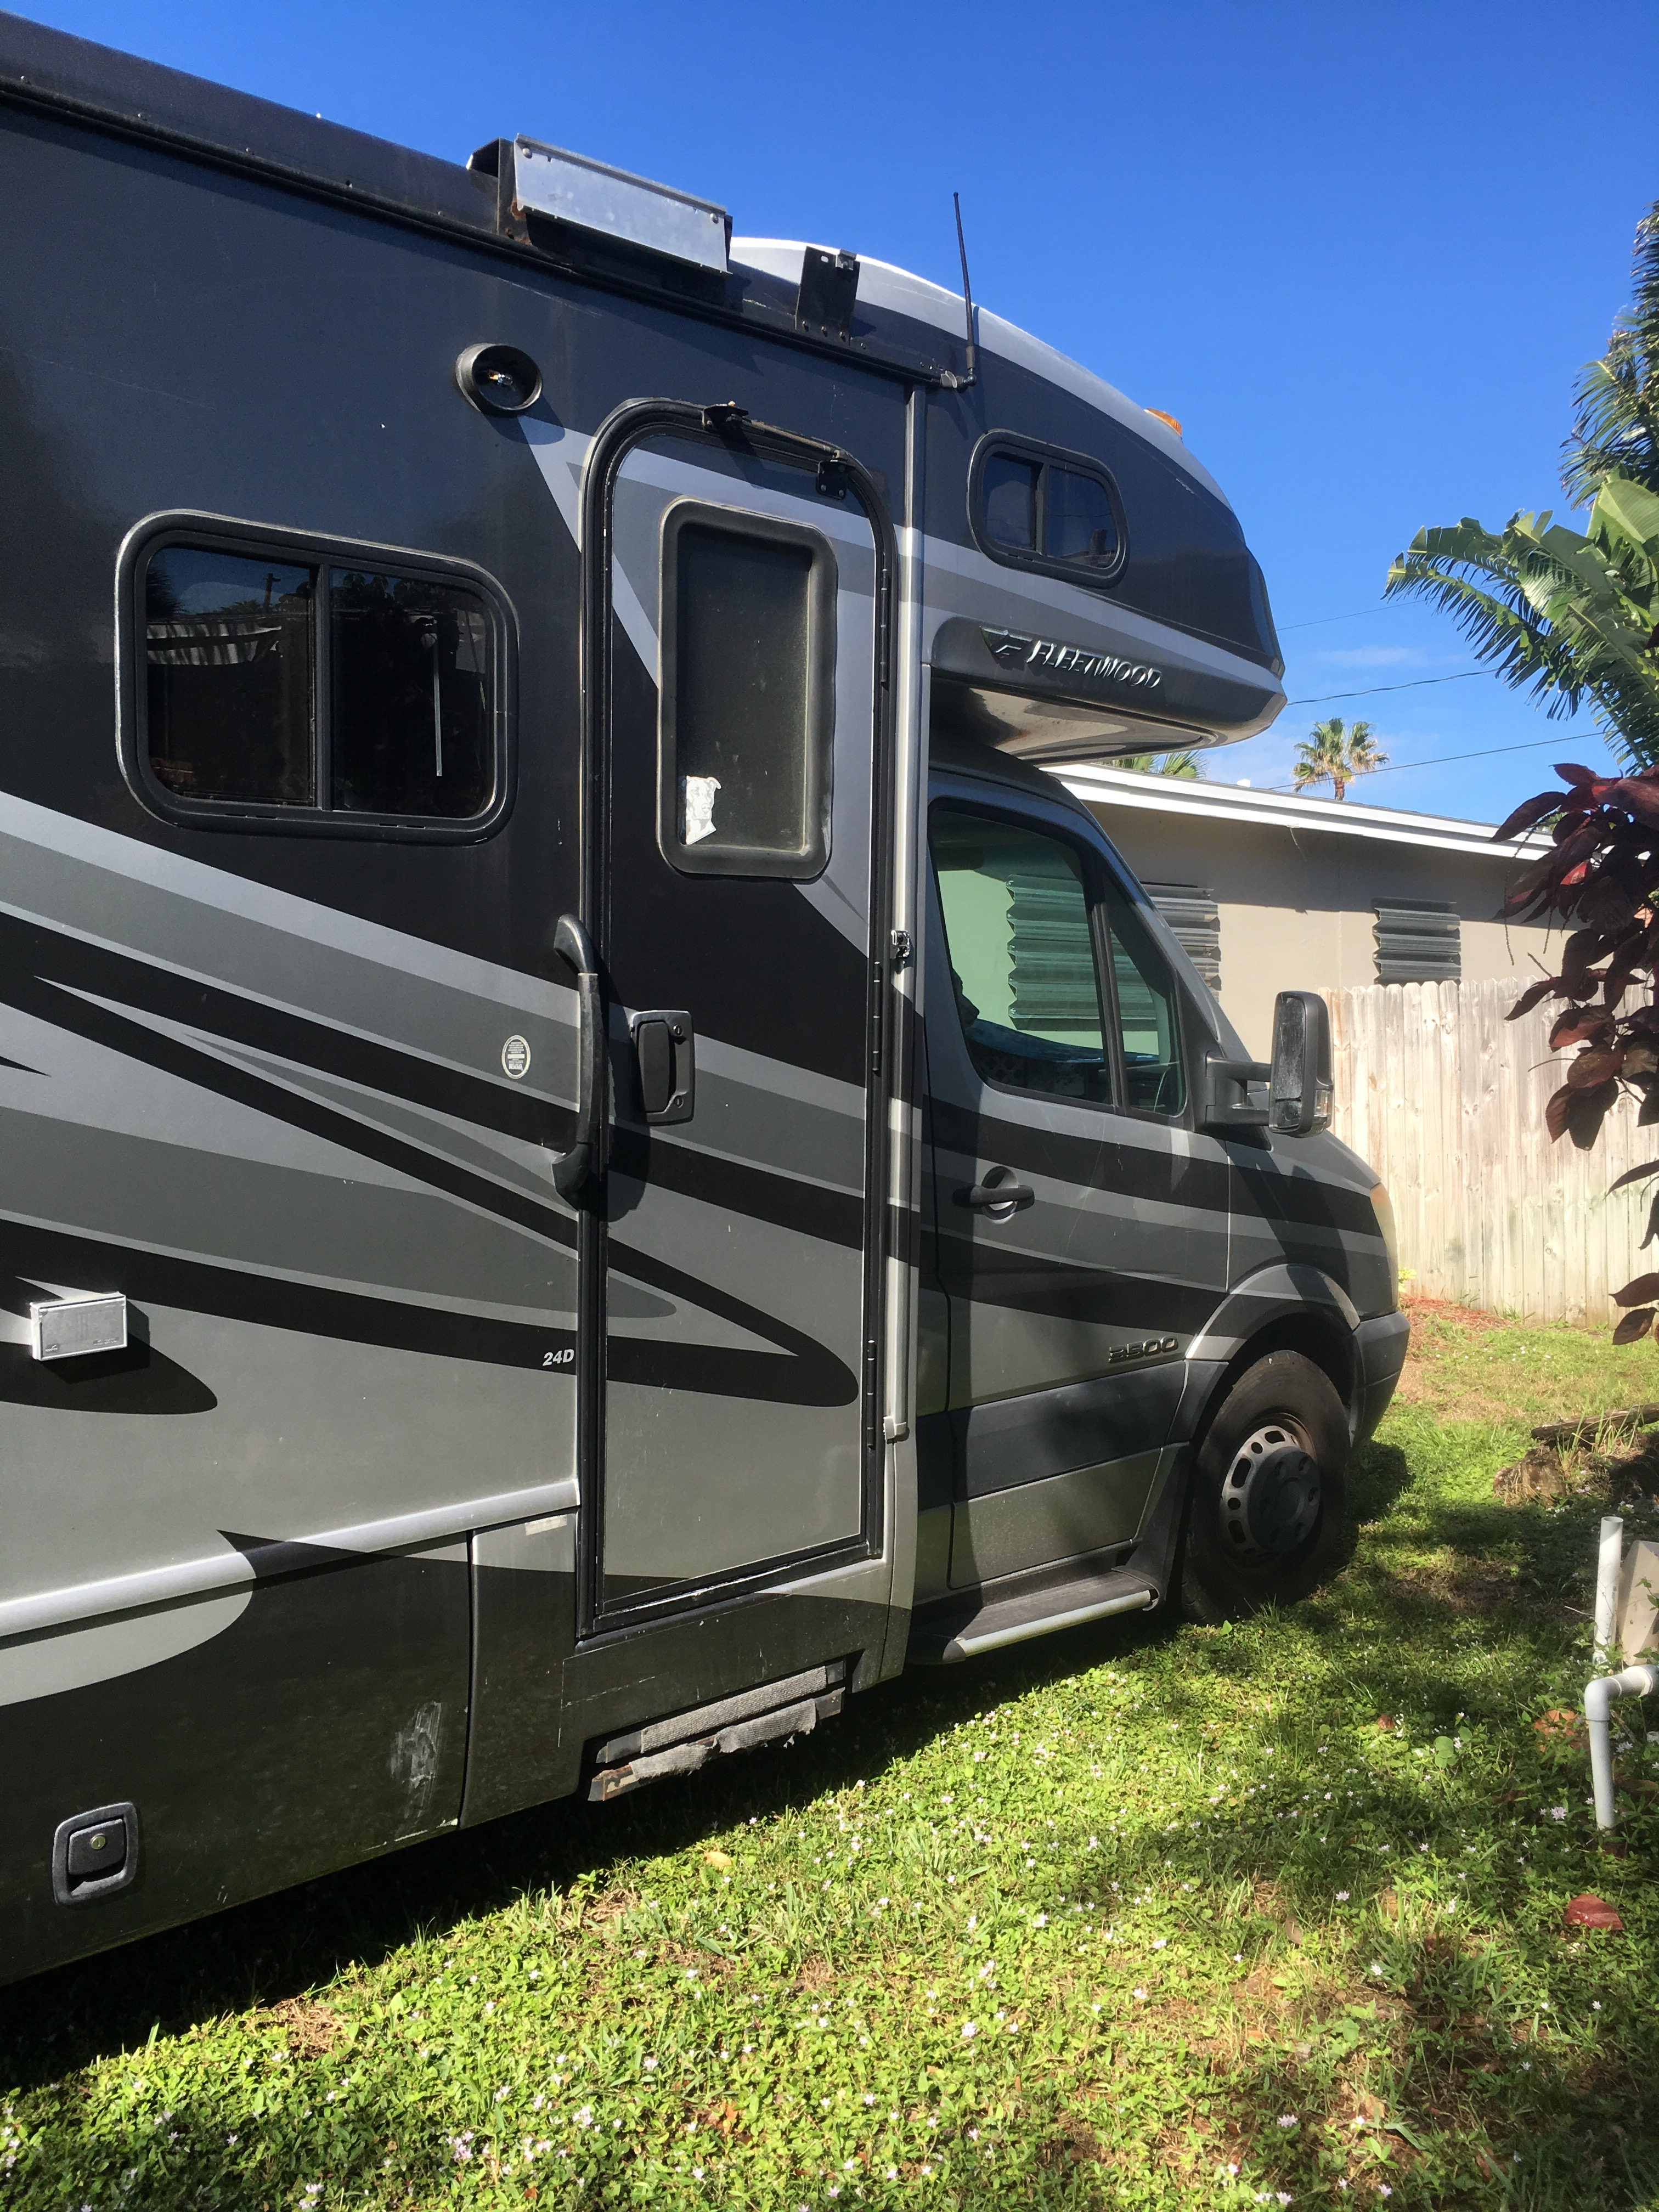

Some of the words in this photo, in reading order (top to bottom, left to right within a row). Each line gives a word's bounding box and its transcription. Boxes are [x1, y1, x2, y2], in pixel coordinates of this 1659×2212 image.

[1026, 640, 1163, 689] FLEETWOOD
[542, 1348, 574, 1366] 24D
[1107, 1335, 1179, 1363] 3500
